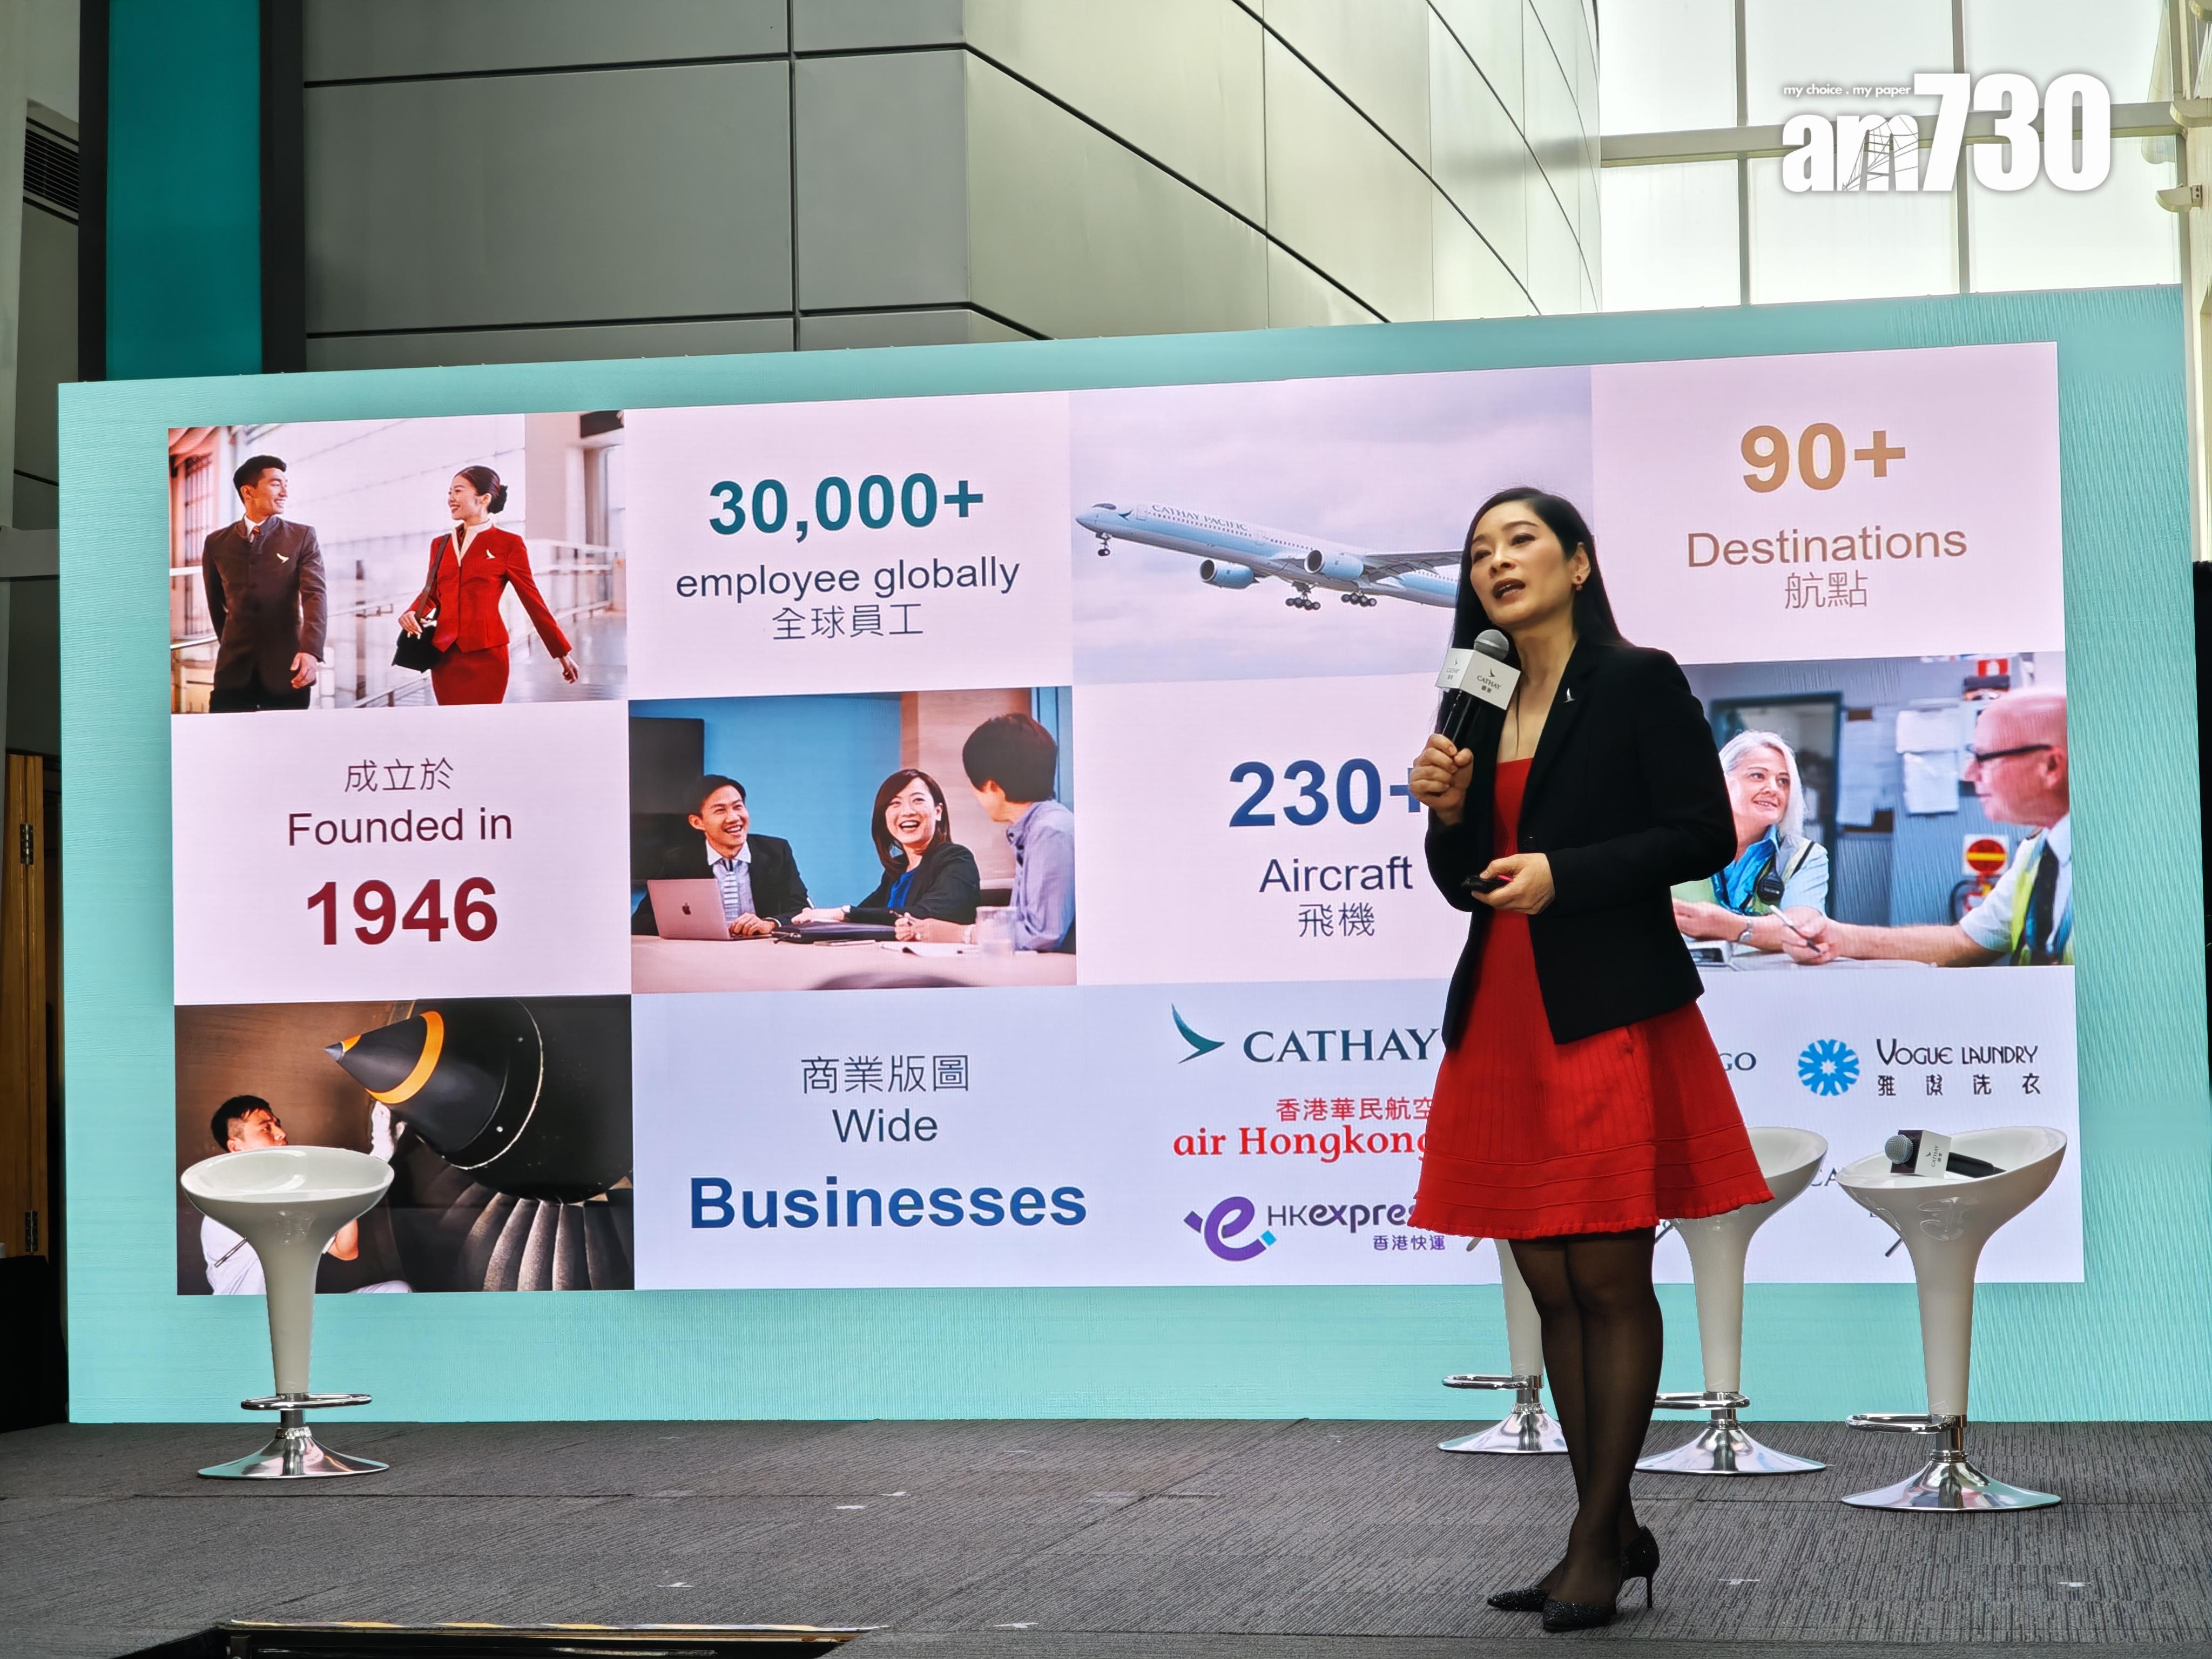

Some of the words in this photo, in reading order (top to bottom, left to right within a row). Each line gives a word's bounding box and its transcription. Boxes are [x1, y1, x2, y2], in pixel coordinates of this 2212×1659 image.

[1740, 422, 1906, 493] 90+
[709, 473, 983, 543] 30,000+
[1152, 504, 1199, 520] CATHAY
[1688, 525, 1967, 568] Destinations
[676, 564, 860, 603] employee
[874, 556, 1020, 598] globally
[1785, 569, 1868, 609] 航點
[772, 603, 924, 640] 全球員工
[1476, 675, 1502, 690] CATHAY
[345, 757, 454, 792] 成立於
[288, 808, 463, 846] Founded
[480, 807, 512, 840] in
[1259, 855, 1413, 893] Aircraft
[307, 876, 497, 945] 1946
[1298, 902, 1375, 938] 飛機
[1243, 1028, 1440, 1063] CATHAY
[1876, 1038, 1953, 1065] VOGUE
[1961, 1046, 2038, 1064] LAUNDRY
[801, 1055, 969, 1094] 商業版圖
[832, 1108, 938, 1143] Wide
[1276, 1096, 1432, 1122] 香港華民航空
[1174, 1128, 1226, 1156] air
[691, 1176, 1087, 1229] Businesses
[1267, 1204, 1415, 1233] HKexpre
[1373, 1235, 1446, 1251] 香港快運
